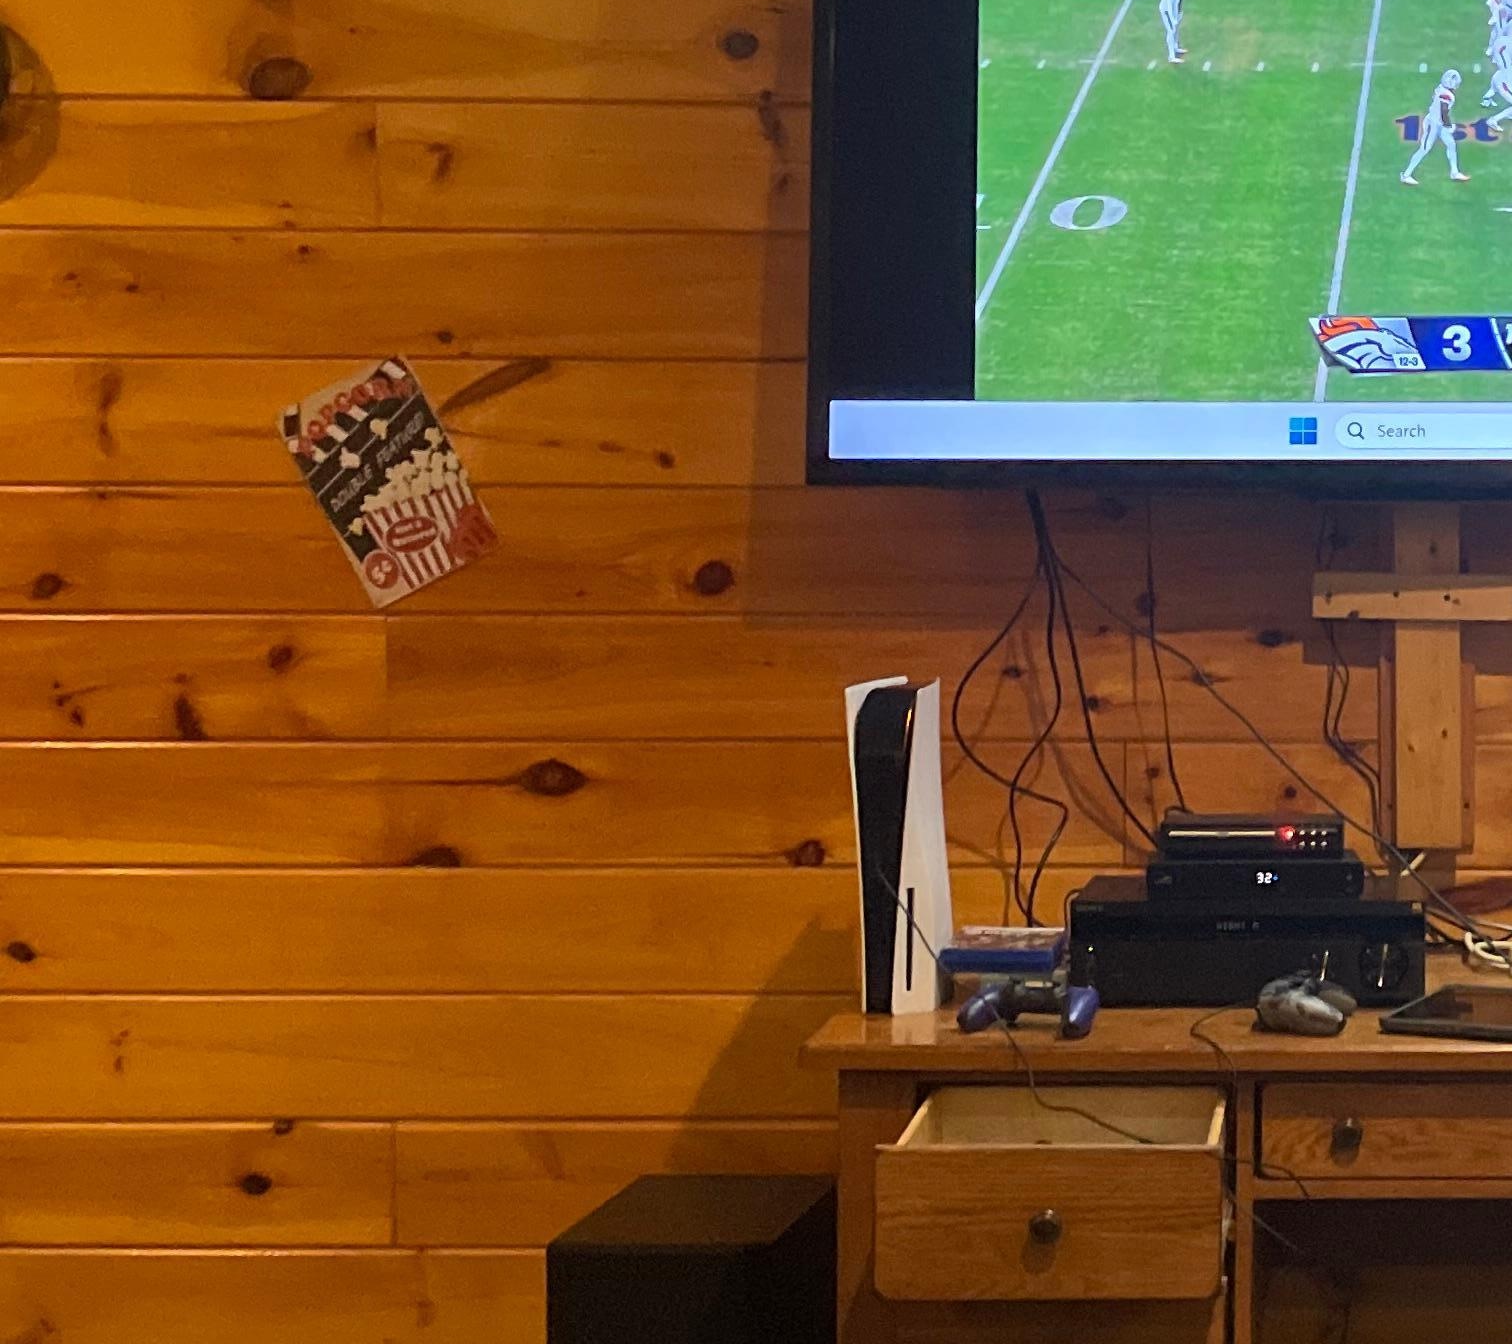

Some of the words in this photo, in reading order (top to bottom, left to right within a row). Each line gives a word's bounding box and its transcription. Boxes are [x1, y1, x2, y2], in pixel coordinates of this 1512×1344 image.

[1441, 324, 1472, 362] 3
[1398, 356, 1419, 367] 12-3
[1376, 422, 1427, 439] Search
